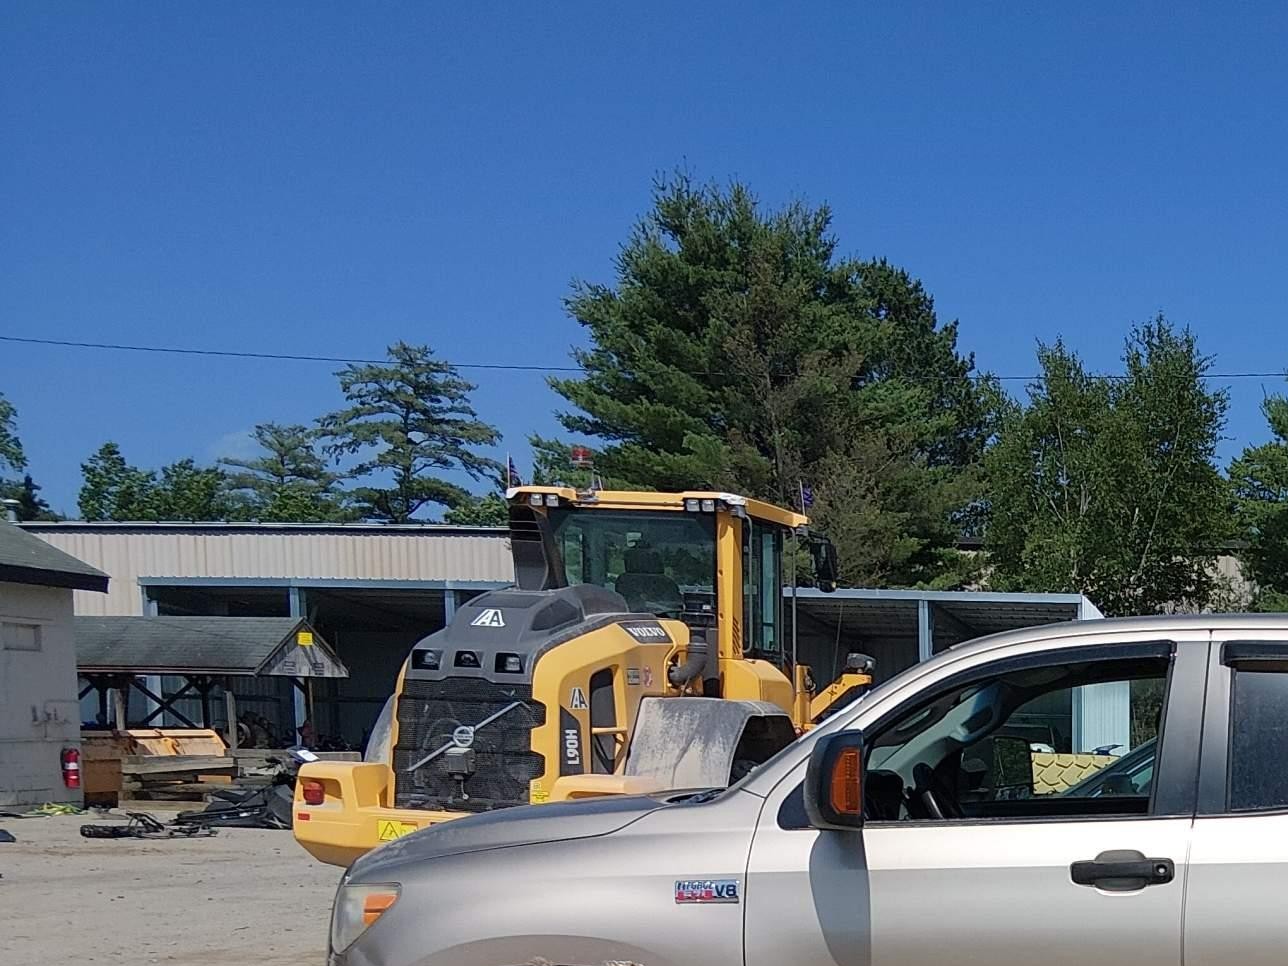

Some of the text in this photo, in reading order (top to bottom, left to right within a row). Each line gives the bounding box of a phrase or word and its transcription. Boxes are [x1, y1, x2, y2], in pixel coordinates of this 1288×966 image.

[626, 627, 666, 637] VOLVO
[564, 729, 581, 765] L90H
[715, 884, 737, 897] V8
